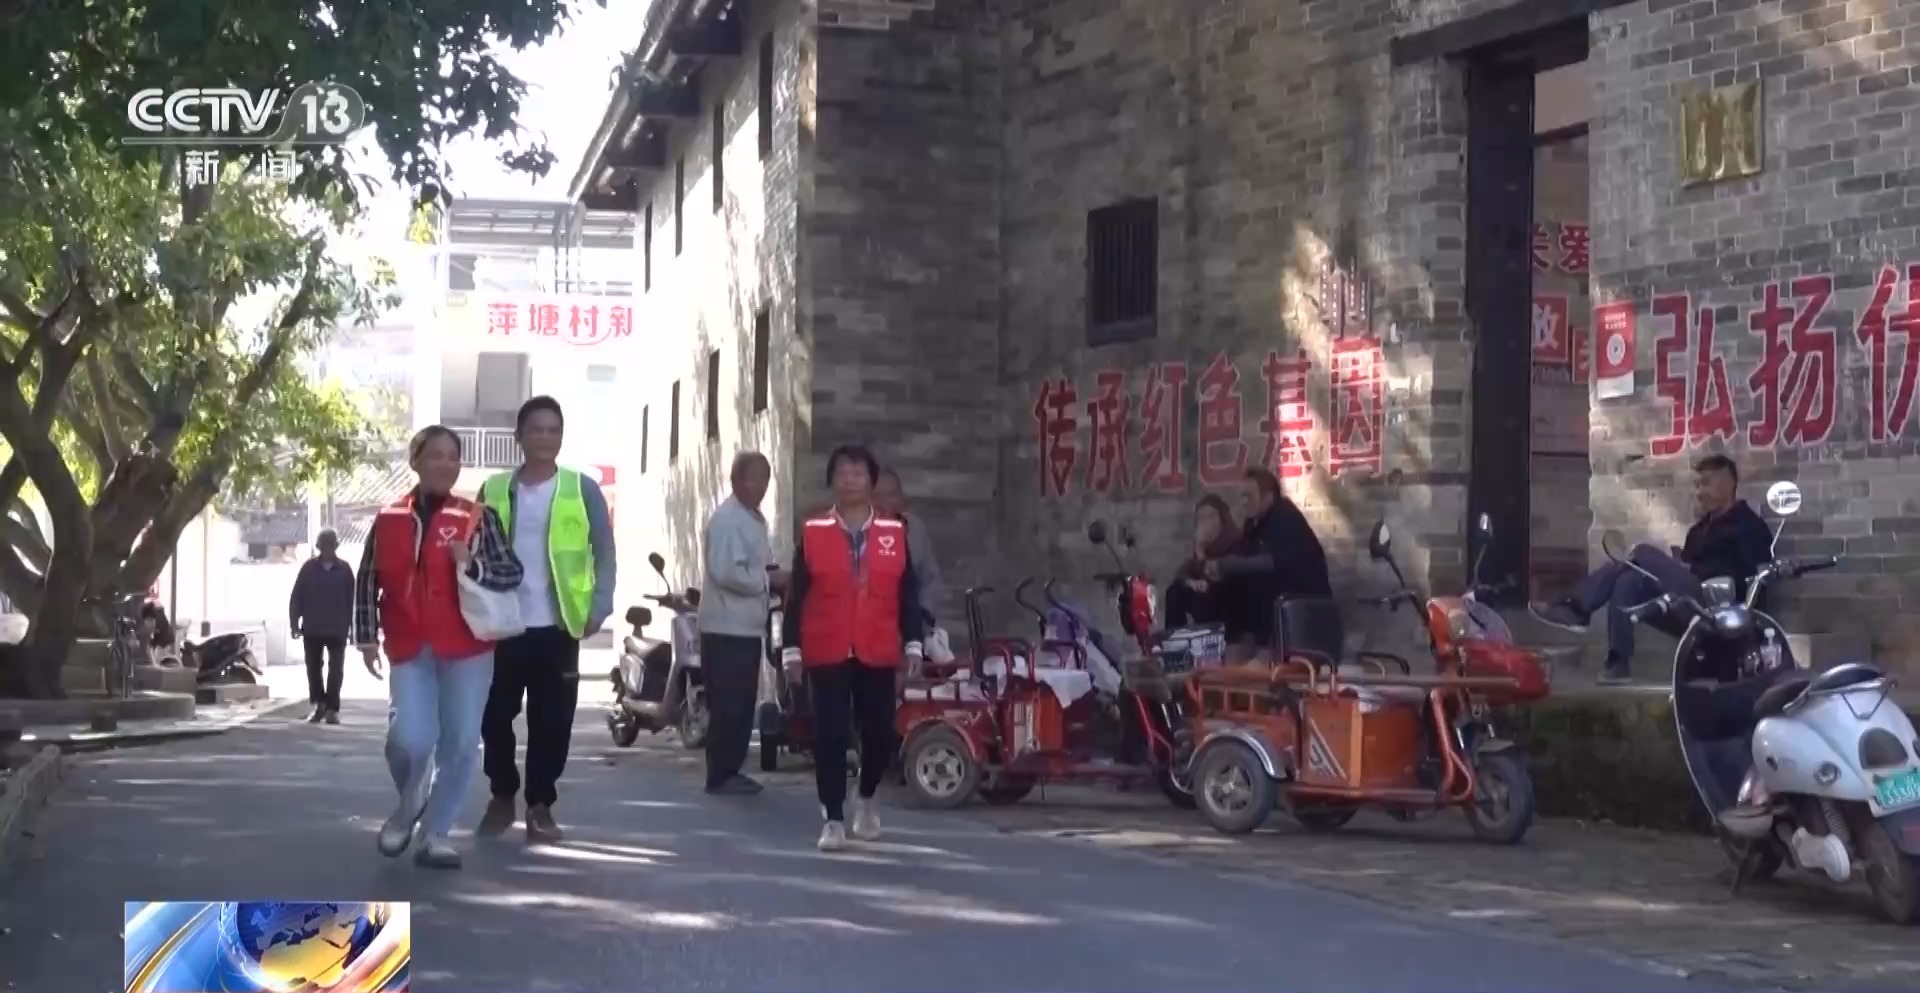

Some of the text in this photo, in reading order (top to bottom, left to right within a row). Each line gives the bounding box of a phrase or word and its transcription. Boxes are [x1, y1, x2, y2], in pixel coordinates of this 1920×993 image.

[1034, 335, 1383, 497] 传承红色基因
